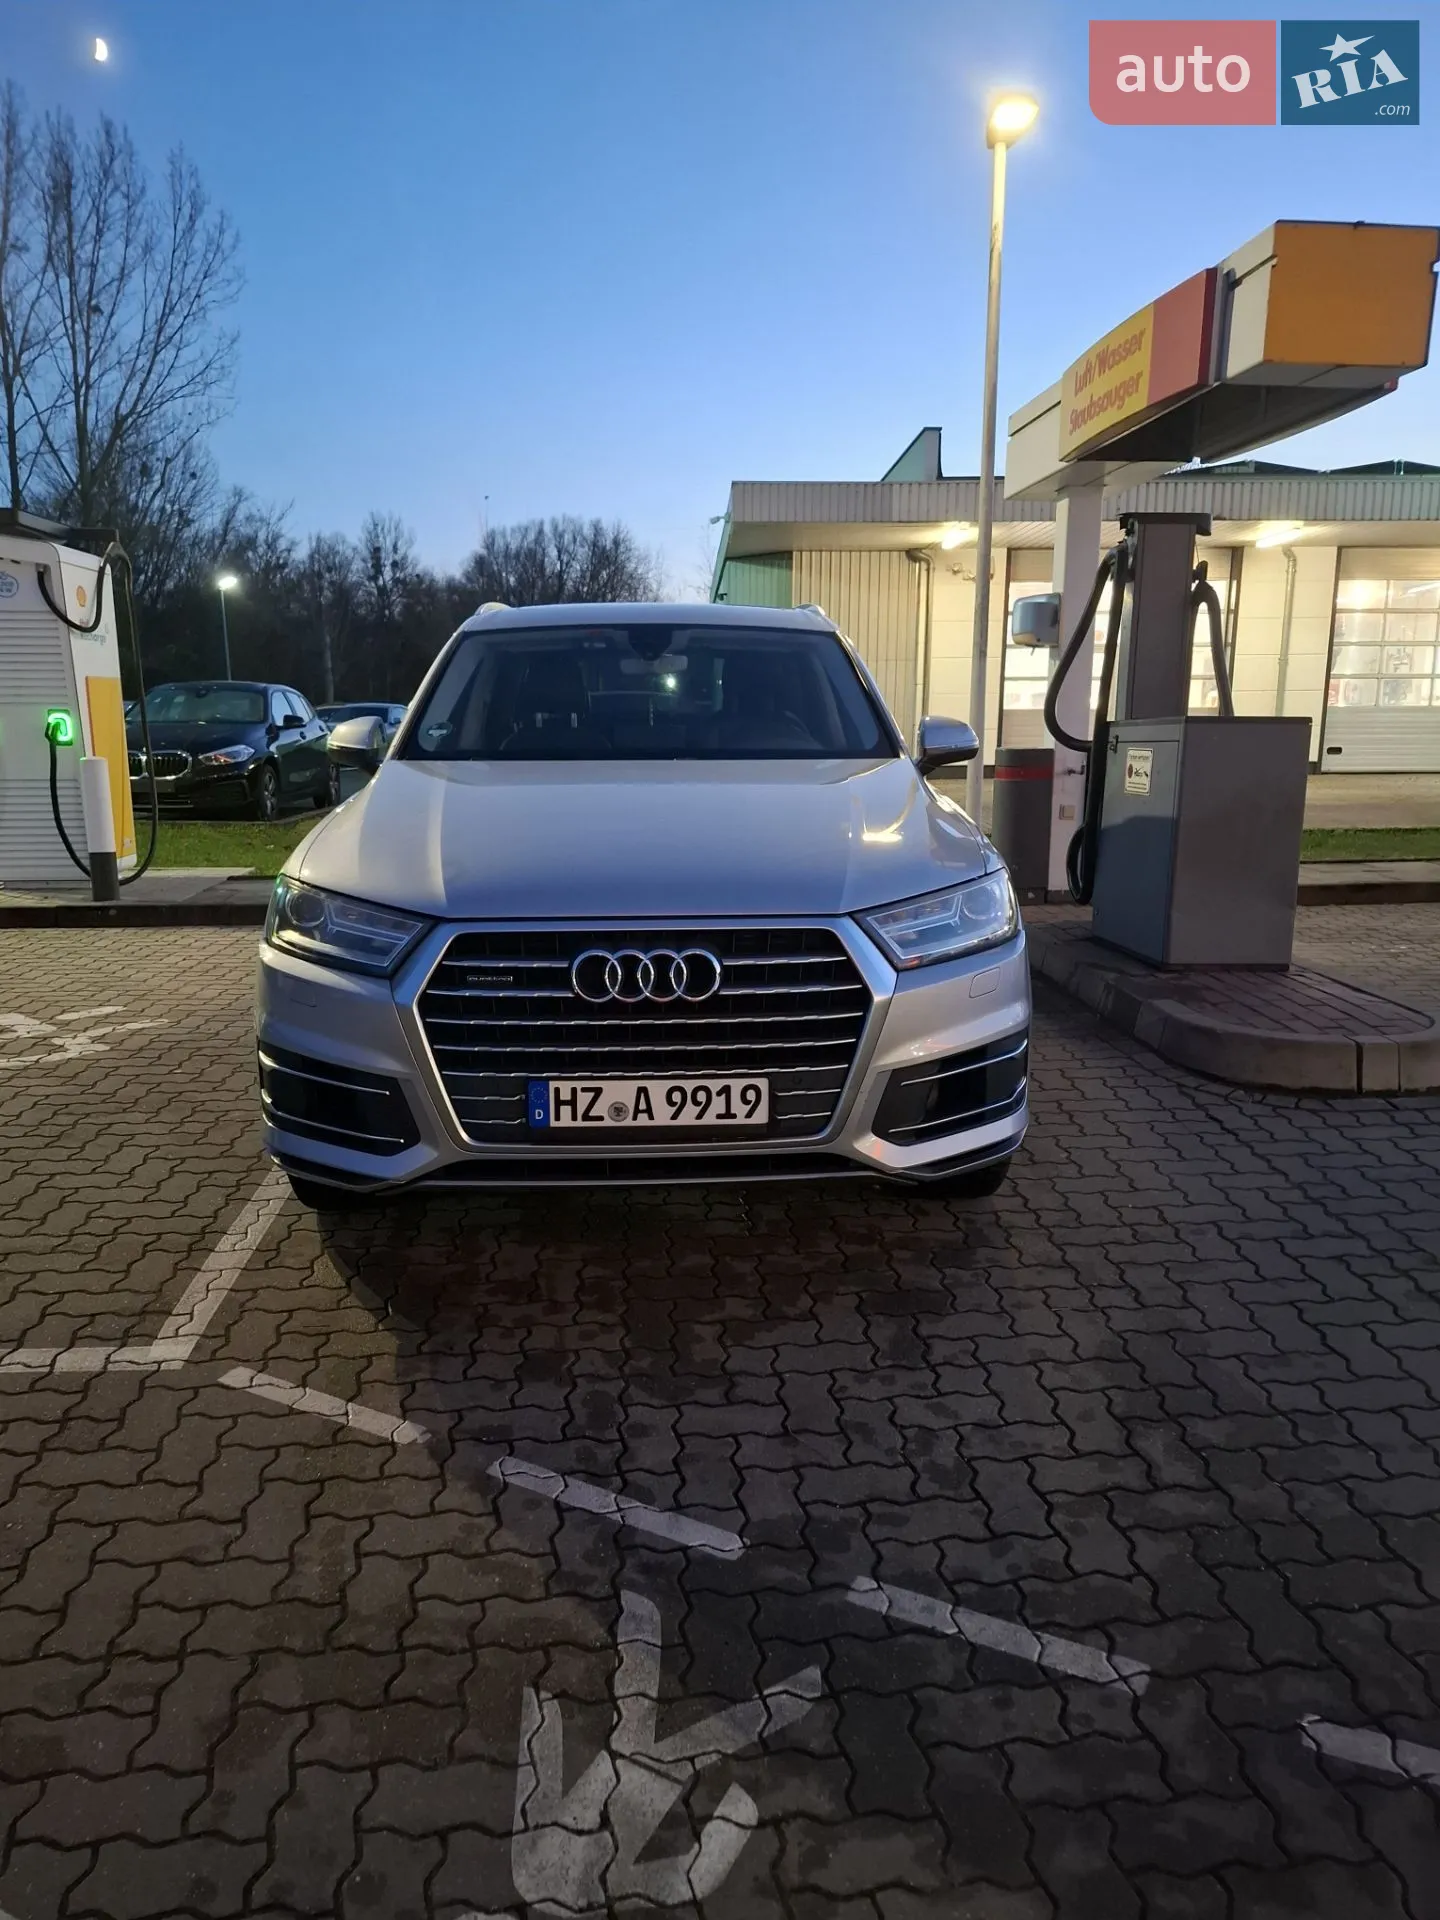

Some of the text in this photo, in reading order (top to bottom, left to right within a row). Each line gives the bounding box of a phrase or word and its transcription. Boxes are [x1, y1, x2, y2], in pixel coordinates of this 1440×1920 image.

[1068, 369, 1143, 436] Staubsauger
[535, 1109, 544, 1120] D
[553, 1084, 762, 1122] HZ A 9919
